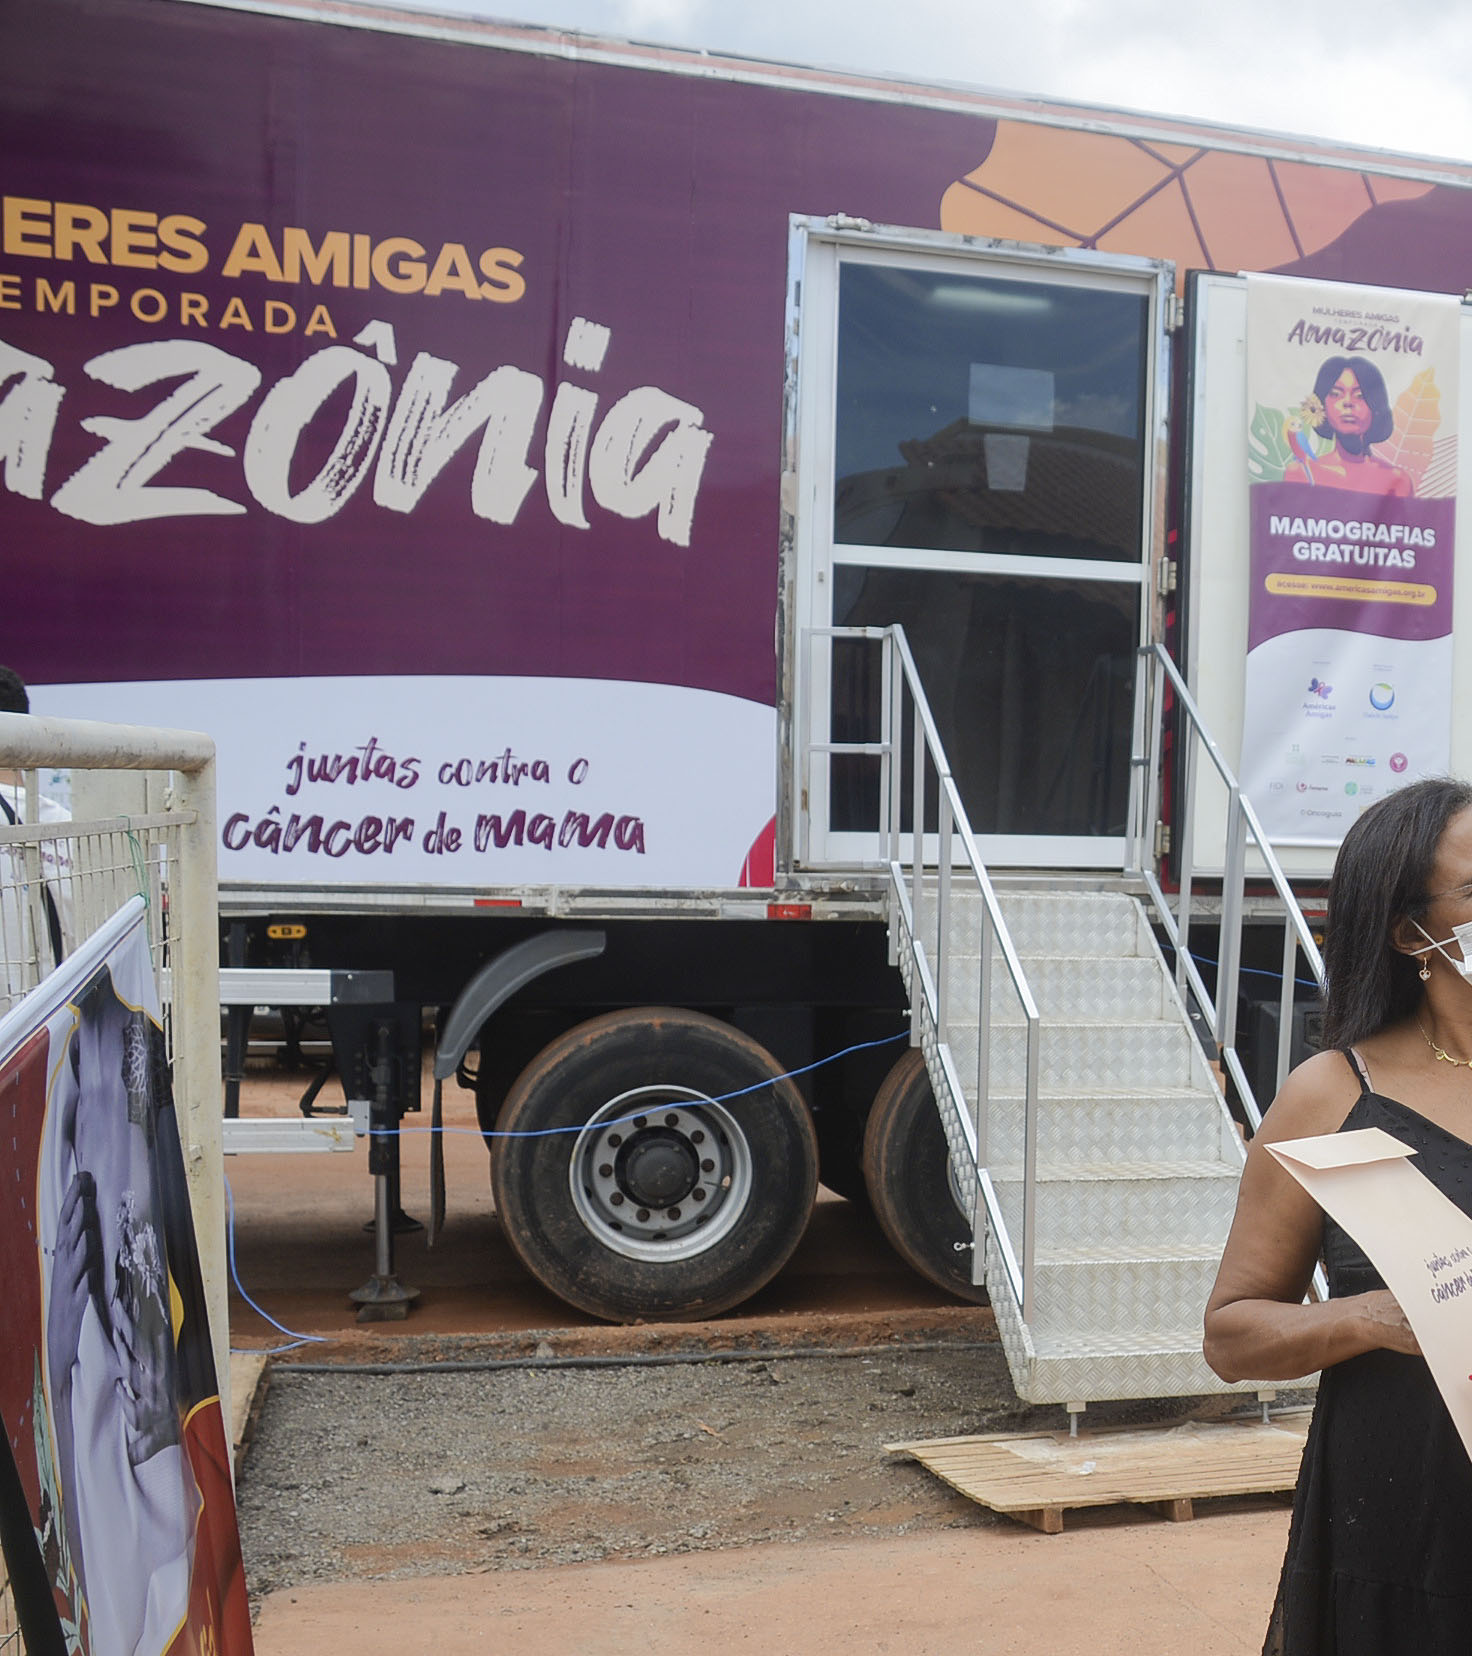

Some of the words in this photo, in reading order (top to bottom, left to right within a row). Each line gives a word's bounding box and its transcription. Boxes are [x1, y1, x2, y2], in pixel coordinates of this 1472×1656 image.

[3, 196, 208, 274] ERES
[222, 223, 526, 303] AMIGAS
[0, 273, 338, 339] EMPORADA
[1269, 515, 1436, 547] MAMOGRAFIAS
[1292, 540, 1416, 568] GRATUITAS
[286, 737, 421, 796] juntas
[438, 747, 550, 787] contra
[567, 757, 589, 786] o
[222, 805, 415, 858] câncer
[422, 811, 463, 856] de
[474, 808, 646, 855] mama
